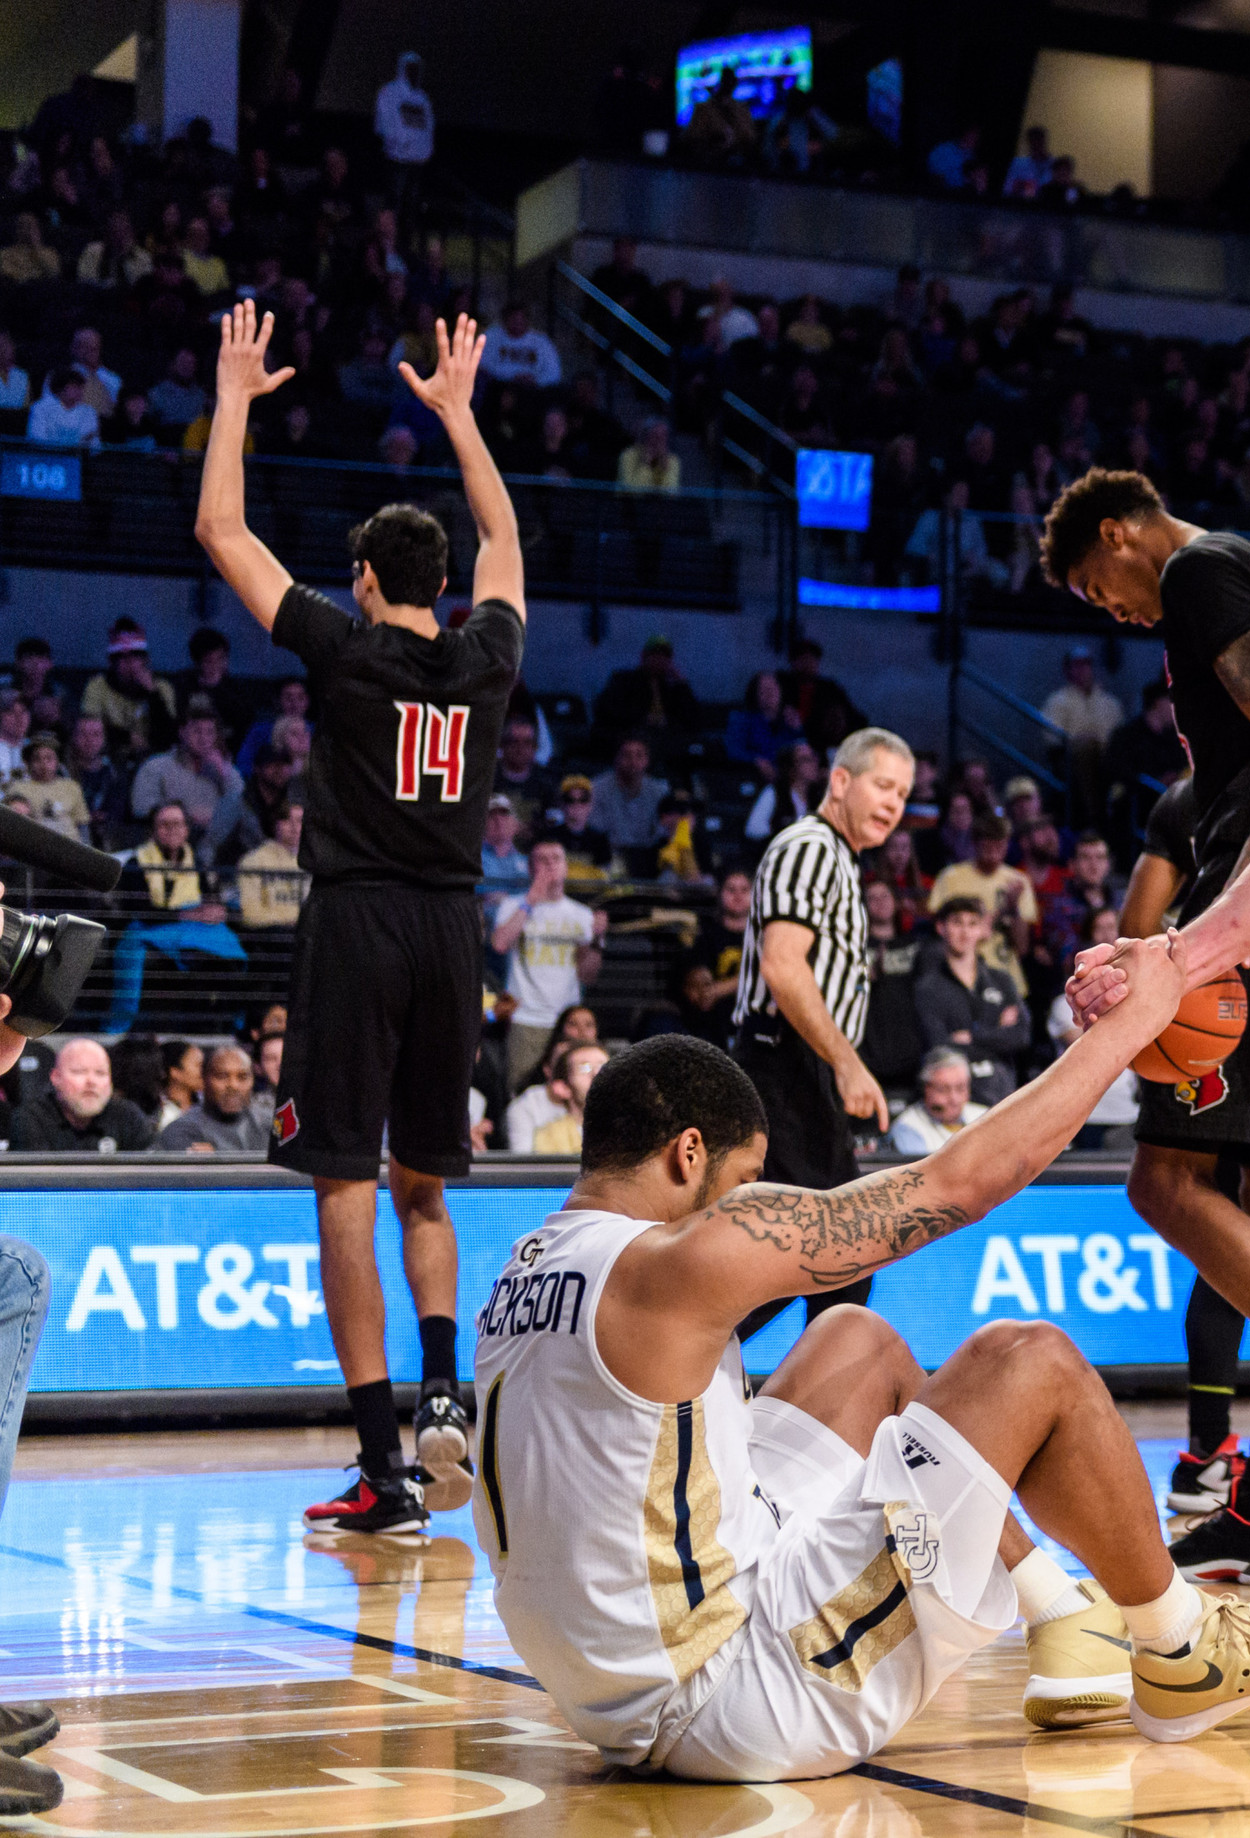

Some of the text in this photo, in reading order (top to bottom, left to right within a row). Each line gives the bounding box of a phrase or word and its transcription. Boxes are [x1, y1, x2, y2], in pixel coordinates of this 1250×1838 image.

[393, 700, 470, 802] 14
[65, 1242, 320, 1330] AT&T
[478, 1270, 586, 1336] ACKSON
[971, 1232, 1173, 1313] AT&T
